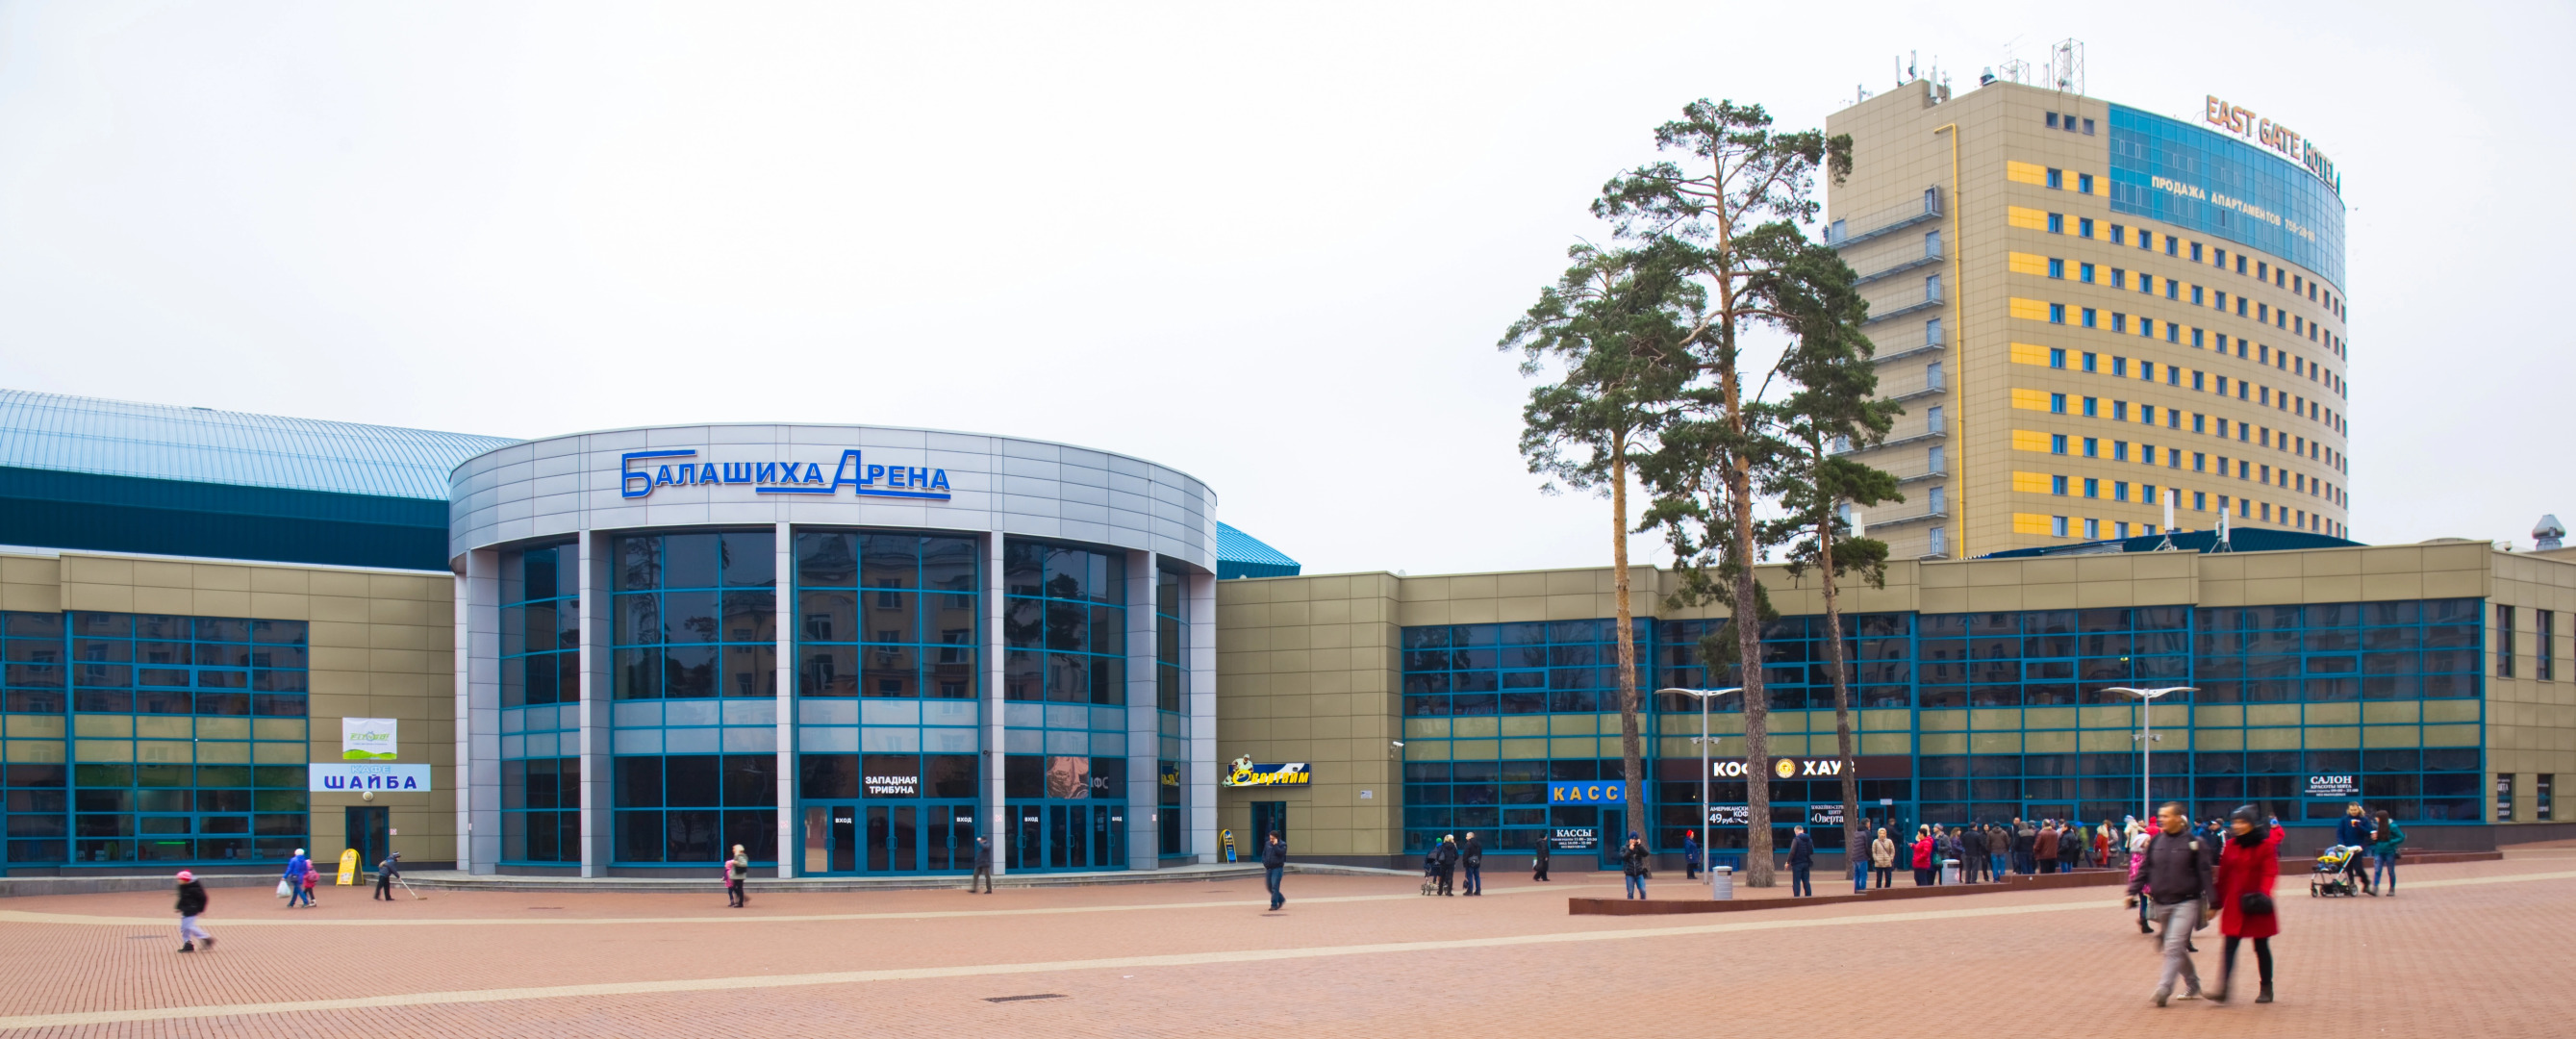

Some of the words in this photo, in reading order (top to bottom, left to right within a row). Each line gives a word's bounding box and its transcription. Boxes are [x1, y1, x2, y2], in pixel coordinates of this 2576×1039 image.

[2207, 94, 2256, 137] EAST
[2260, 117, 2301, 161] GATE
[2304, 139, 2336, 190] HOTEL
[2152, 176, 2206, 201] ПРОДАЖА
[2211, 193, 2281, 226] АПАРТАМЕНТОВ
[351, 765, 391, 774] КАФЕ
[1713, 761, 1749, 777] КО
[324, 774, 417, 790] ШАЙБА
[865, 775, 918, 785] ЗАПАДНАЯ
[2311, 775, 2352, 784] САЛОН
[869, 785, 915, 795] ТРИБУНА
[1553, 785, 1628, 801] КАСС
[1708, 813, 1723, 824] 49
[1556, 828, 1592, 837] КАССЫ
